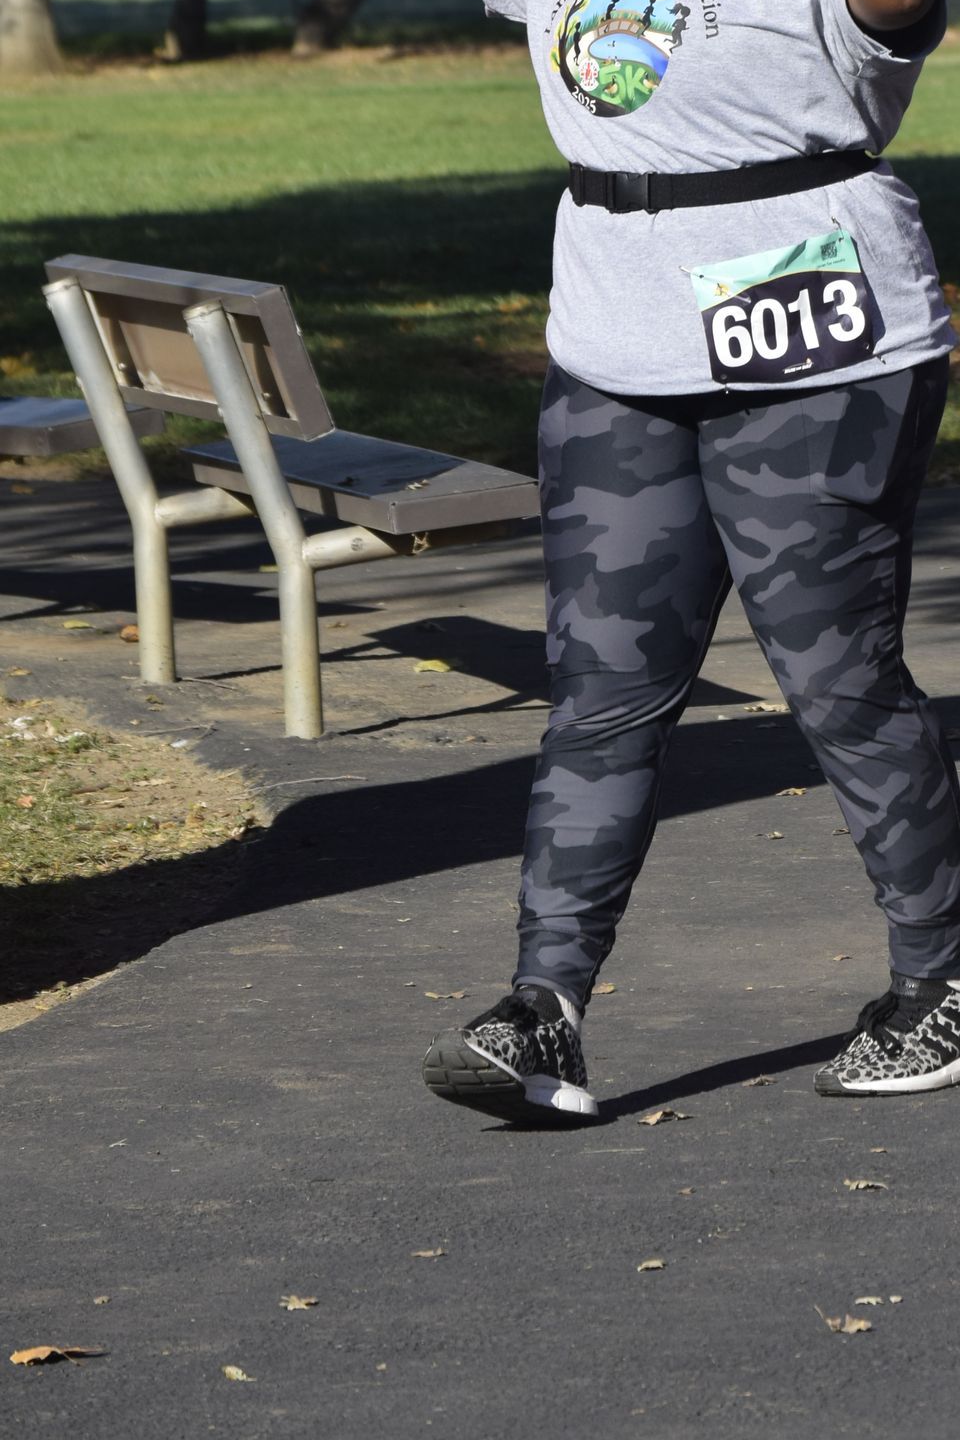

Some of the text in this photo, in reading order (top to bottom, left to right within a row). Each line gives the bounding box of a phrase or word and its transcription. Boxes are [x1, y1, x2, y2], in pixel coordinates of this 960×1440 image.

[572, 86, 596, 114] 2025
[599, 65, 651, 110] 5K
[712, 280, 865, 367] 6013
